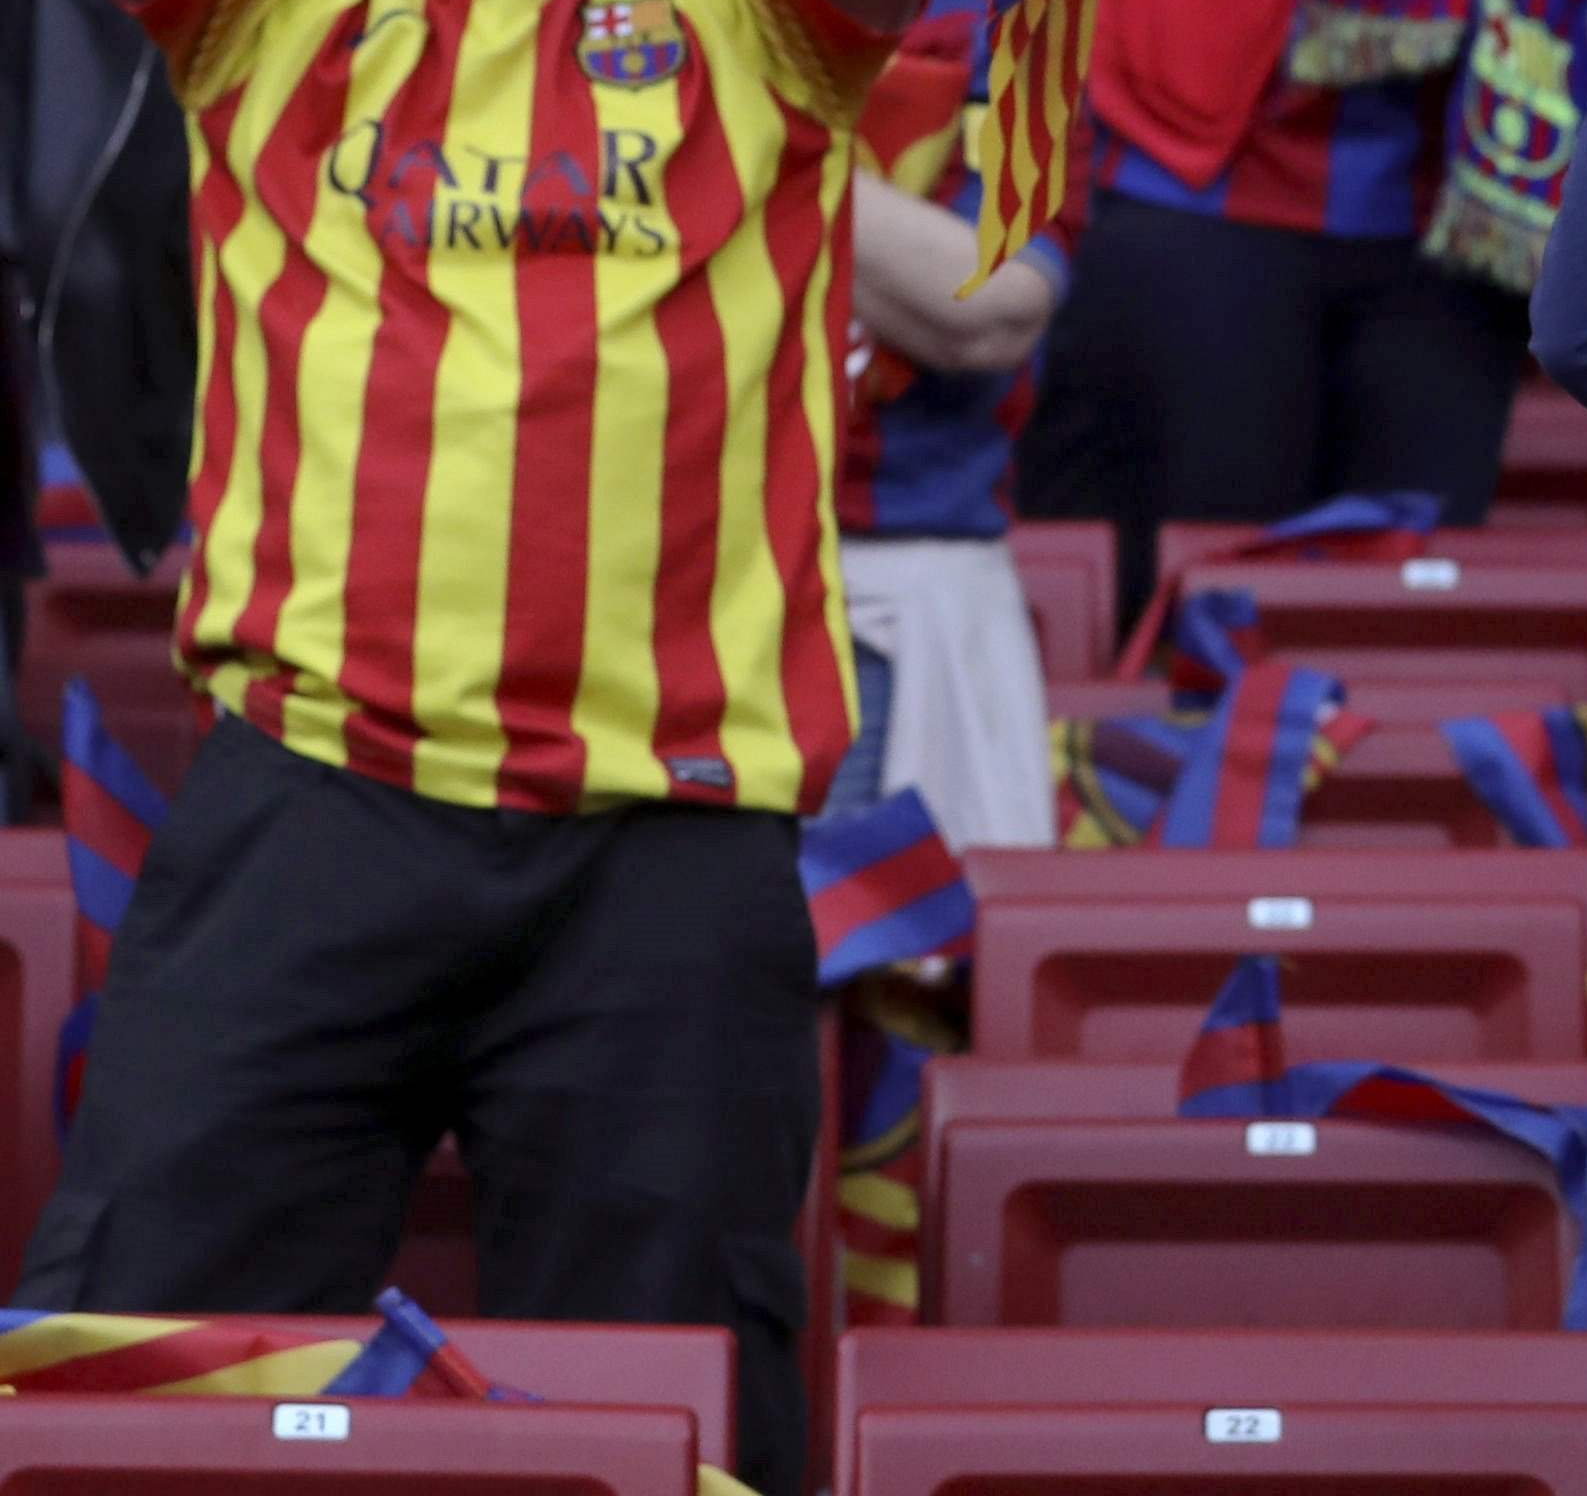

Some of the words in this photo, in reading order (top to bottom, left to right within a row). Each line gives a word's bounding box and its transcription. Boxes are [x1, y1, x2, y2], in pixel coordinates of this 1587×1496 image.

[328, 119, 657, 207] QATAR
[382, 198, 667, 257] AIRWAYS
[295, 1410, 326, 1433] 21
[1225, 1414, 1260, 1437] 22
